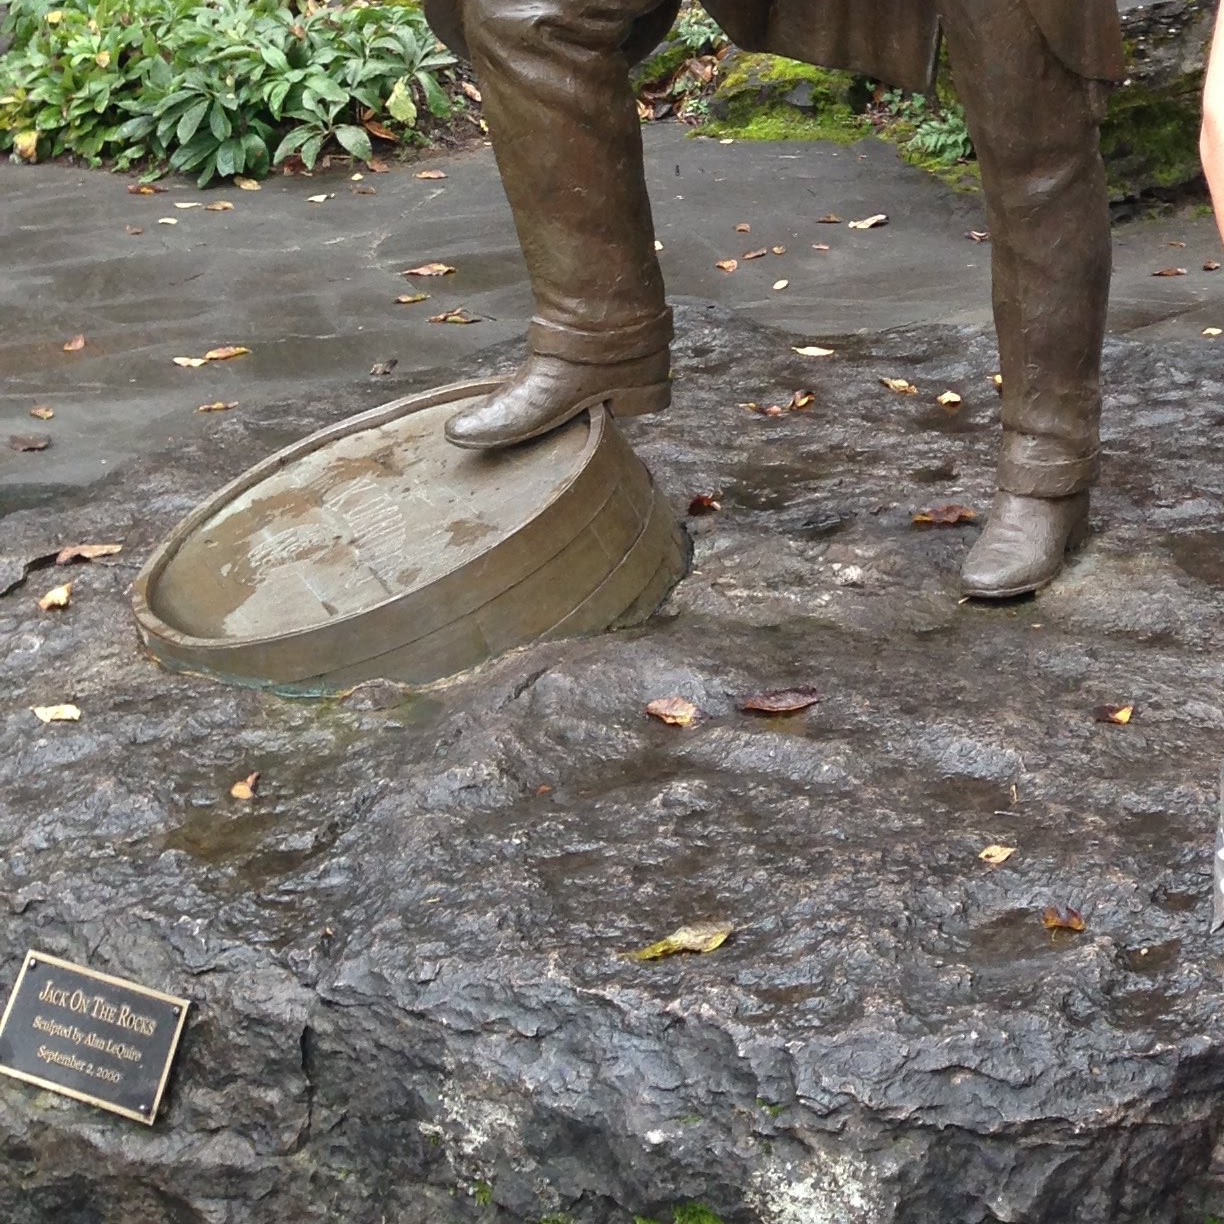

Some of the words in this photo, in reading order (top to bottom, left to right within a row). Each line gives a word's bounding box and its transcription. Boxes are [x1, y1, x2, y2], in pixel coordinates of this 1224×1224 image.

[38, 979, 70, 1007] JACK
[70, 988, 91, 1014] ON
[91, 996, 117, 1023] THE
[116, 1004, 157, 1036] ROCKS
[32, 1015, 73, 1038] Sculpted
[72, 1026, 85, 1045] by
[84, 1032, 105, 1050] Alan
[37, 1044, 86, 1072] September
[96, 1066, 121, 1084] 2000
